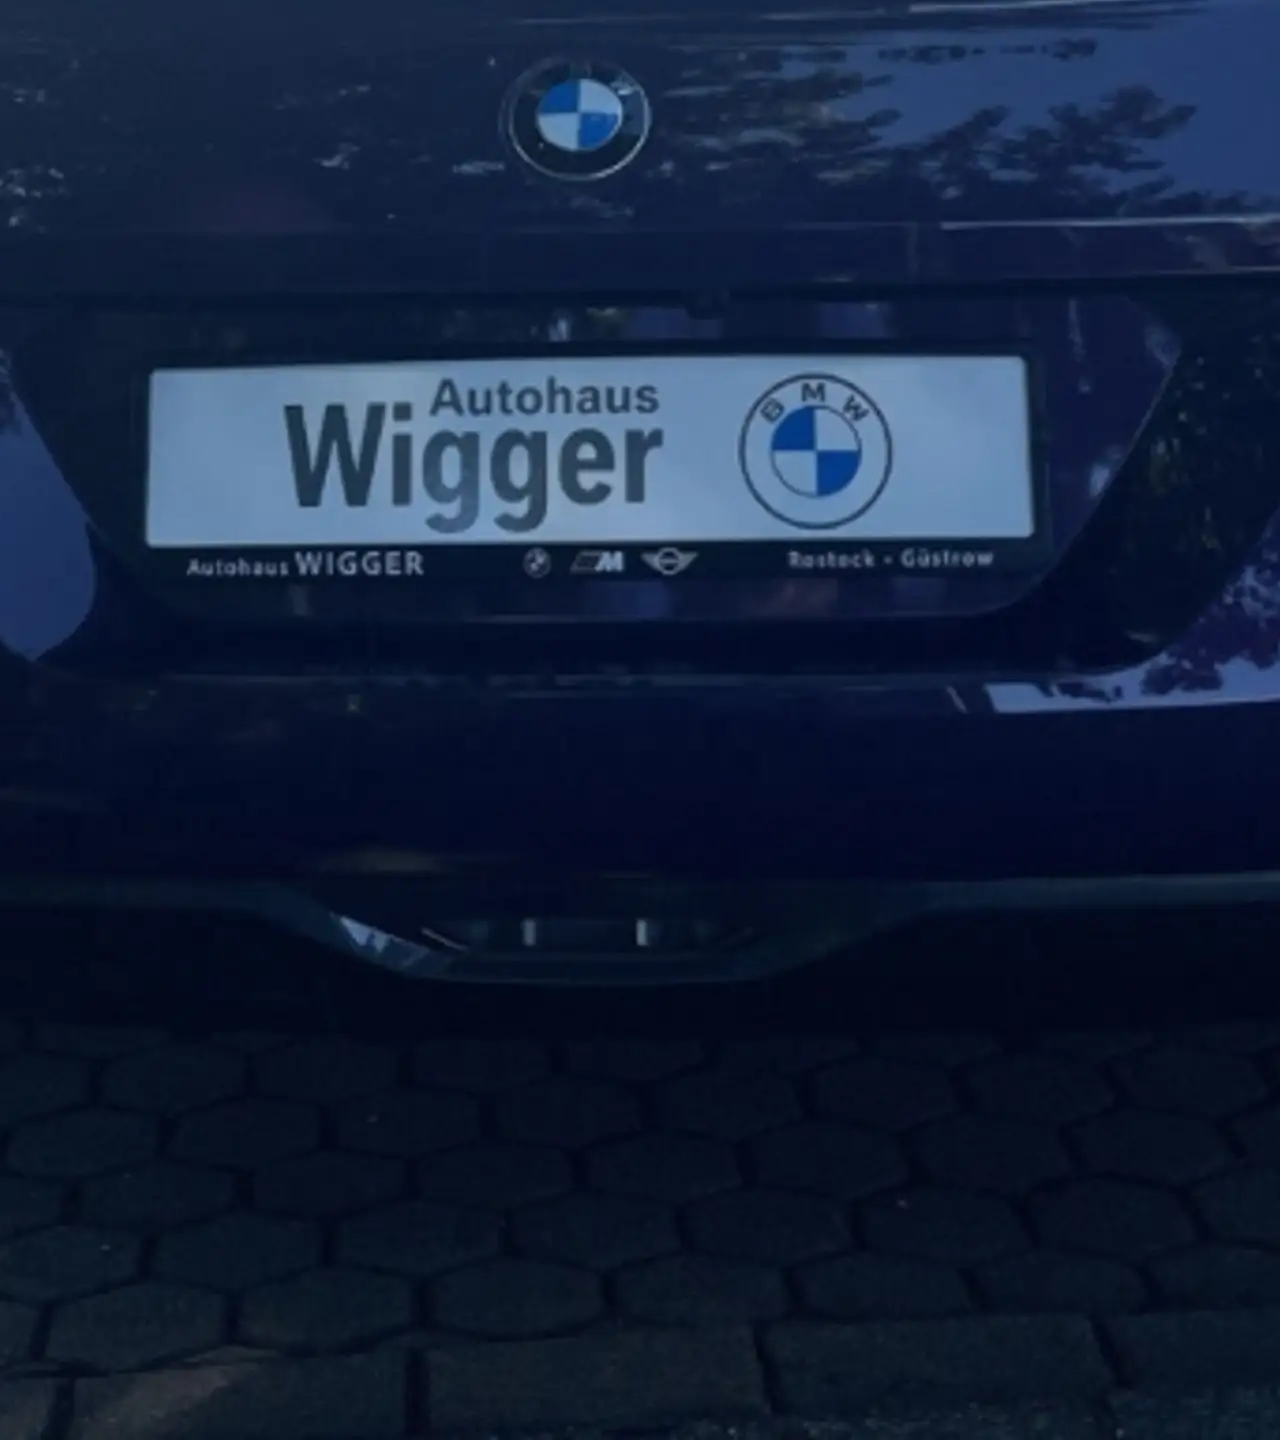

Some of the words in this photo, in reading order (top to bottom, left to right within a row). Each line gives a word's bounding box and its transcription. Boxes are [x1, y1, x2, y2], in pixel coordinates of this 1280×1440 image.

[429, 375, 660, 417] Autohaus
[760, 382, 870, 424] BMW
[283, 401, 664, 534] Wigger
[186, 558, 290, 577] Autohaus
[294, 550, 425, 577] WIGGER
